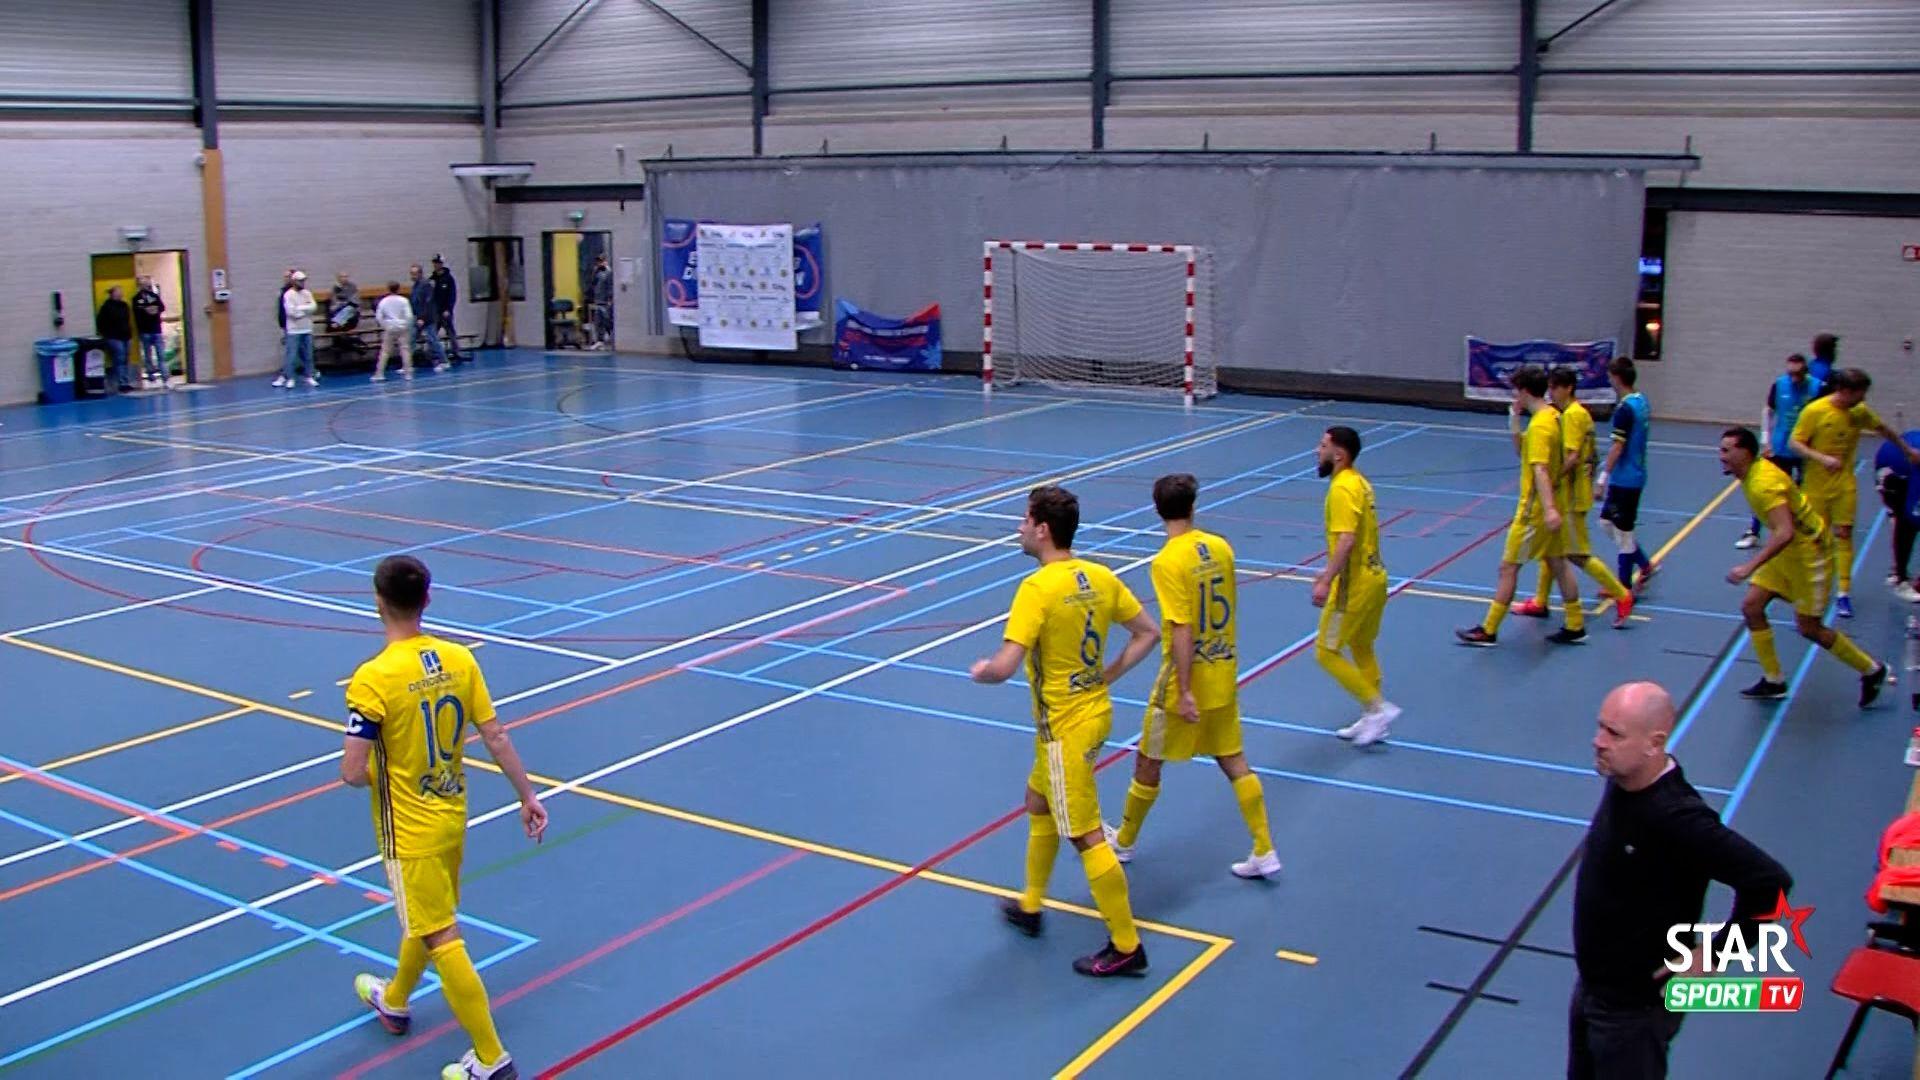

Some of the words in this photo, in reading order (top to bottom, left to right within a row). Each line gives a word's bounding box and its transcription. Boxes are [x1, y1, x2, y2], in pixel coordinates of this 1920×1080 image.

[1198, 577, 1230, 634] 15
[1081, 610, 1101, 667] 6
[421, 695, 463, 767] 10
